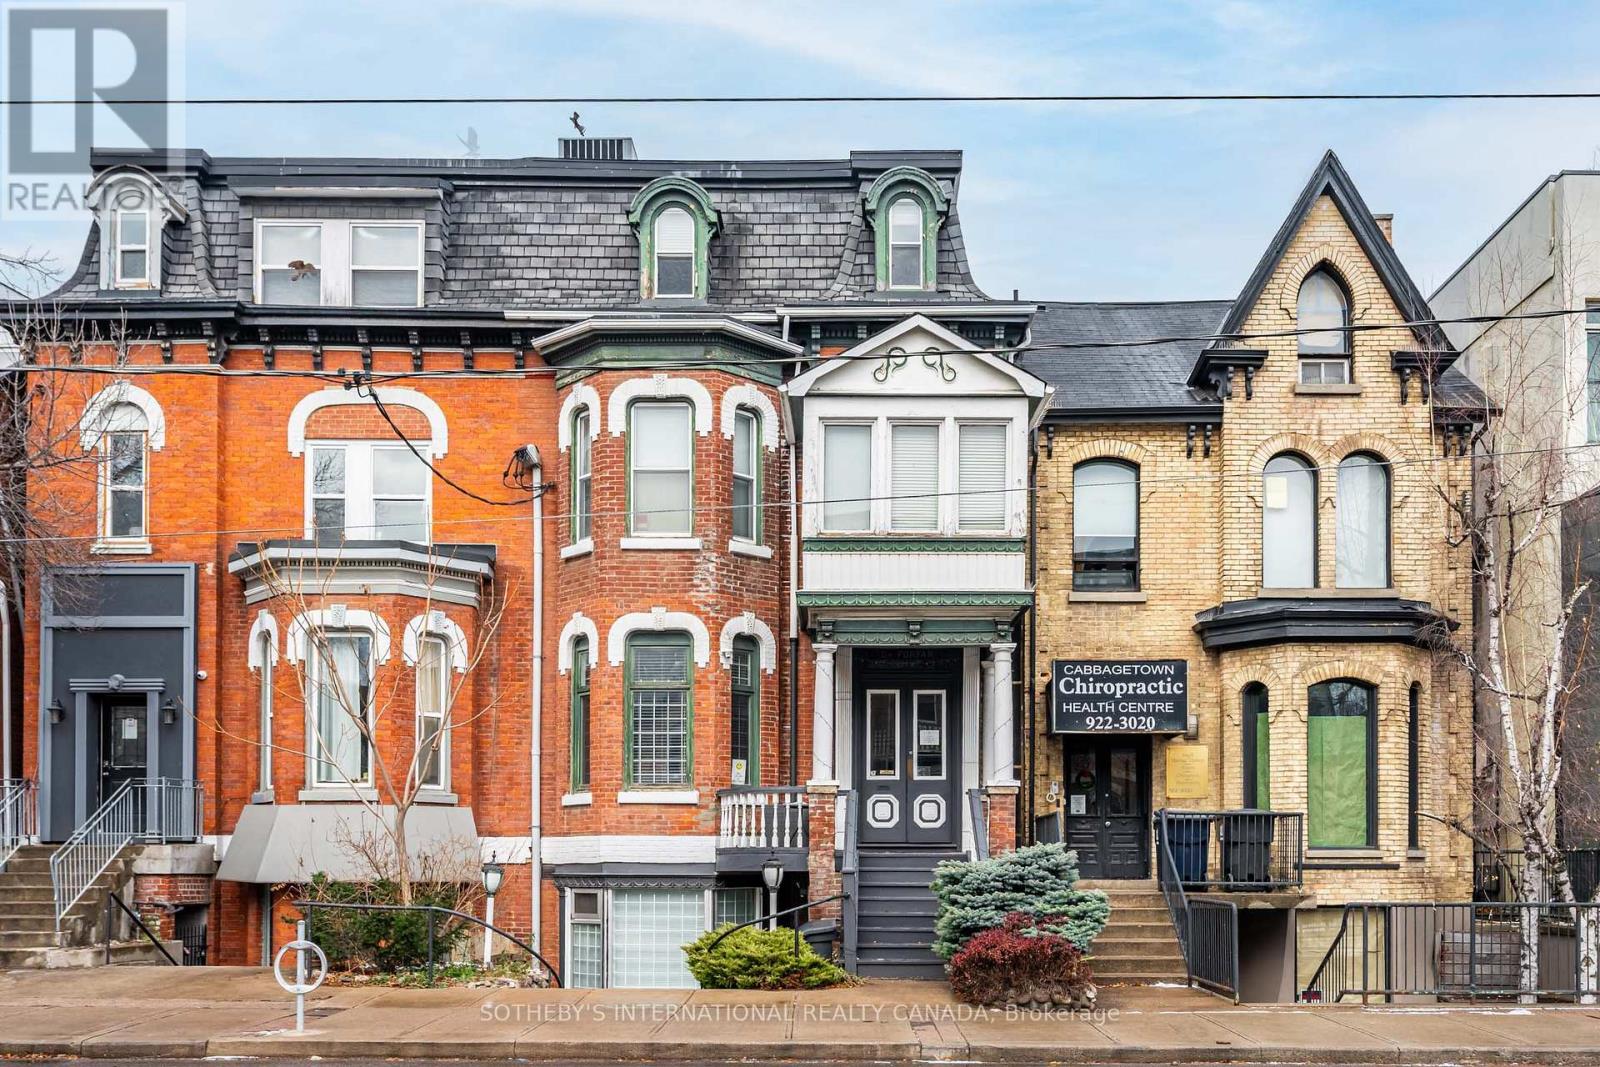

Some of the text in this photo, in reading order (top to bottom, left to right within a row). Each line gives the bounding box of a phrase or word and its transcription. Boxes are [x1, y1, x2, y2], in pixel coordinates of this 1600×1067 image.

[1063, 664, 1175, 675] CABBAGETOWN
[1059, 677, 1184, 698] Chiropractic
[1063, 702, 1174, 713] HEALTH CENTRE
[1085, 716, 1156, 731] 922-3020
